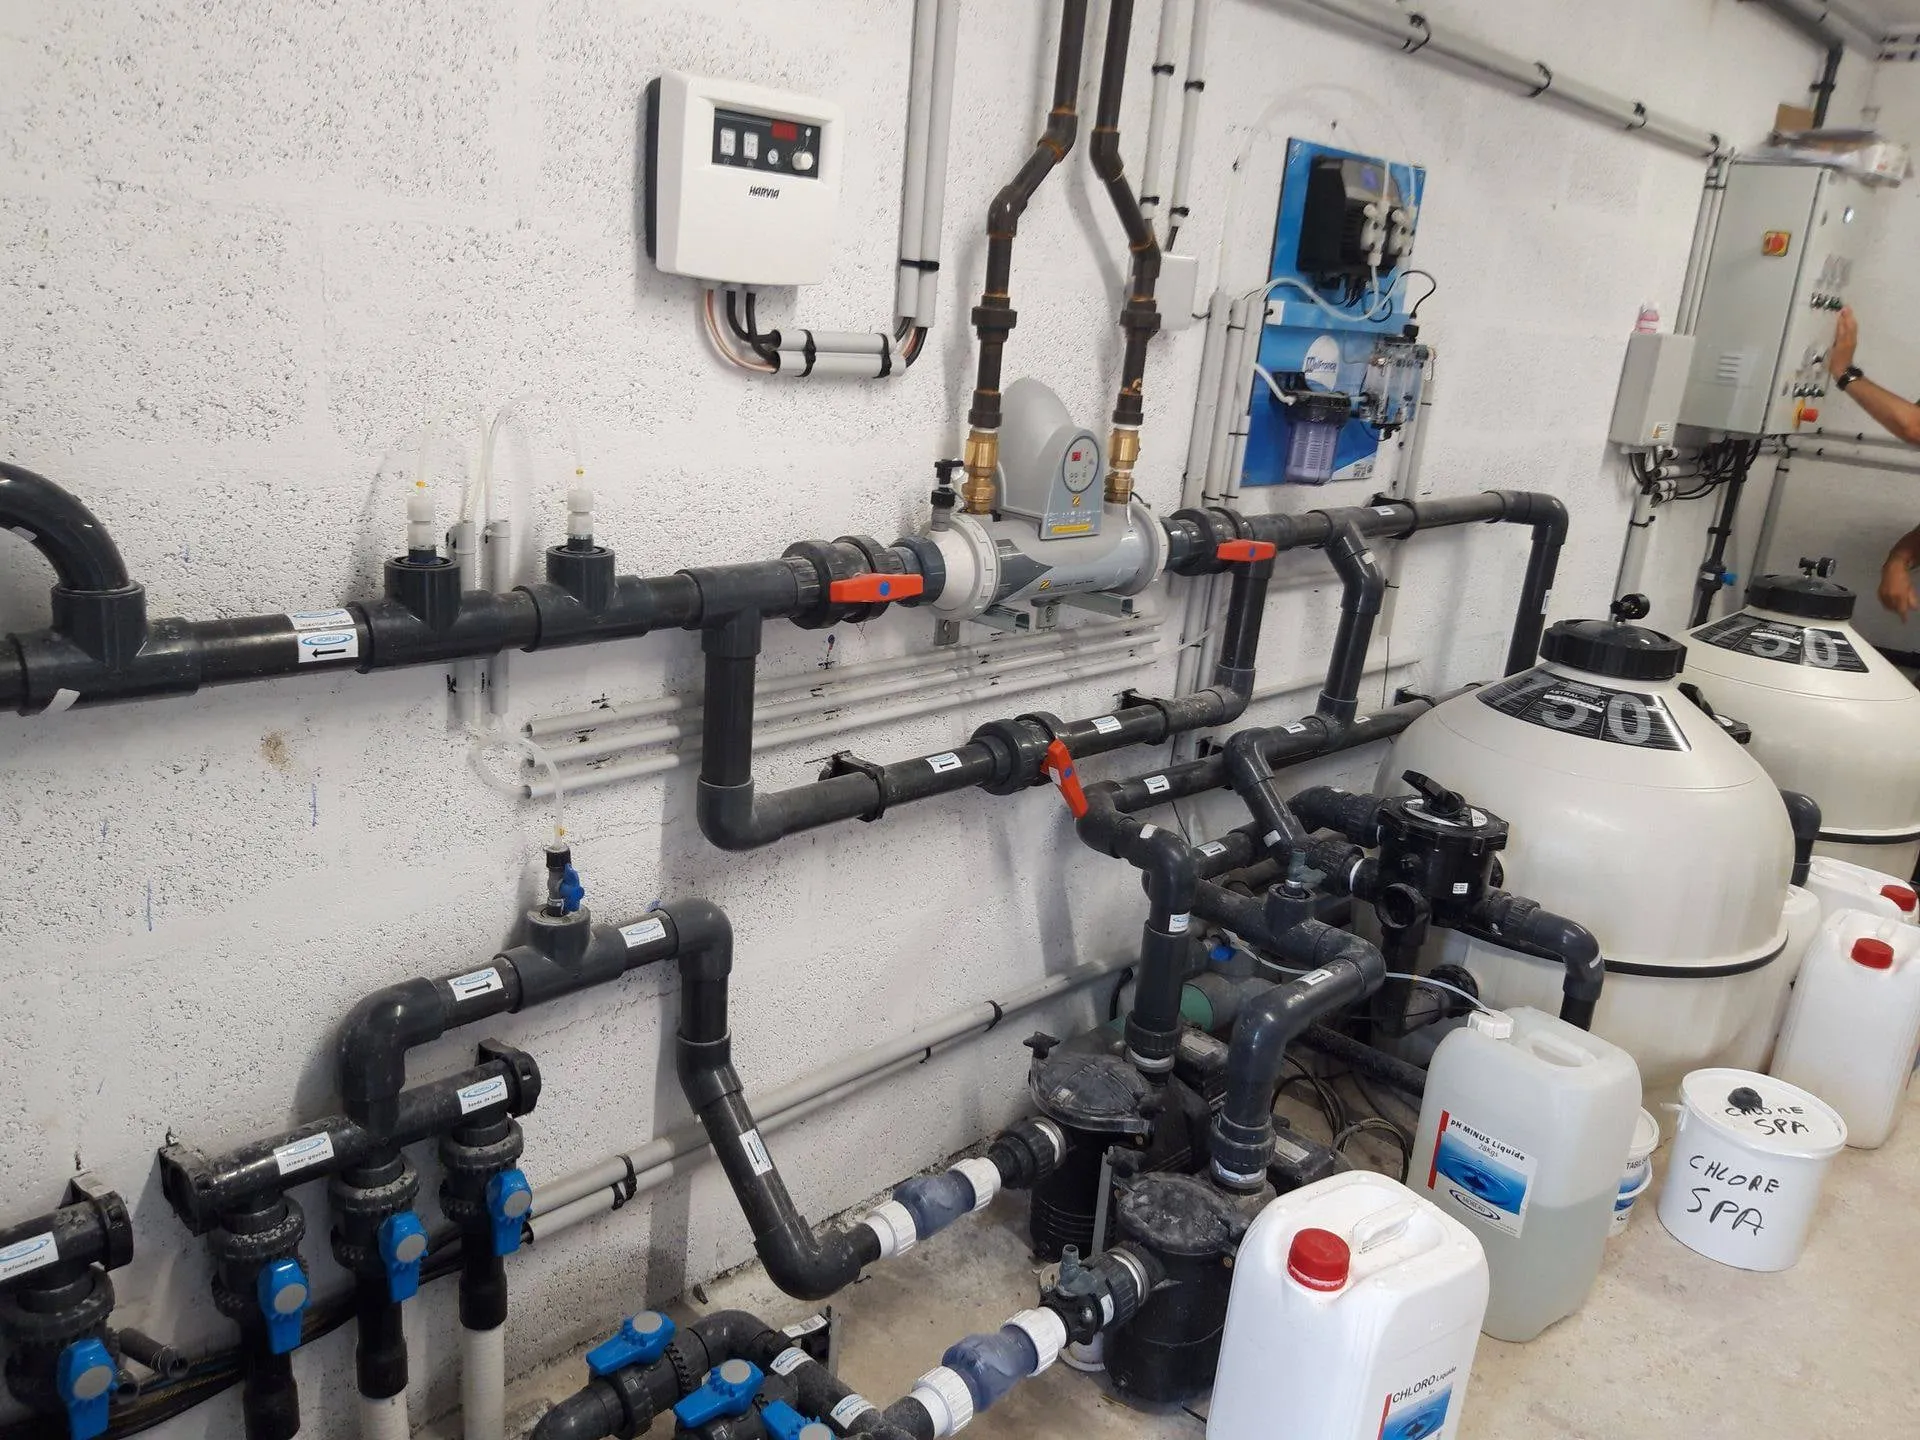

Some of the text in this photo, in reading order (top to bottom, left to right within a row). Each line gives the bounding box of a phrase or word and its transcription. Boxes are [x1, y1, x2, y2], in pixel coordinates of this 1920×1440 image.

[748, 184, 780, 200] HARVIA
[1450, 1119, 1525, 1161] pH MINUS Liquide
[1754, 1118, 1810, 1136] SPA
[1689, 1155, 1780, 1194] CHLORE
[1687, 1187, 1764, 1236] SPA
[1392, 1375, 1436, 1403] CHLORO
